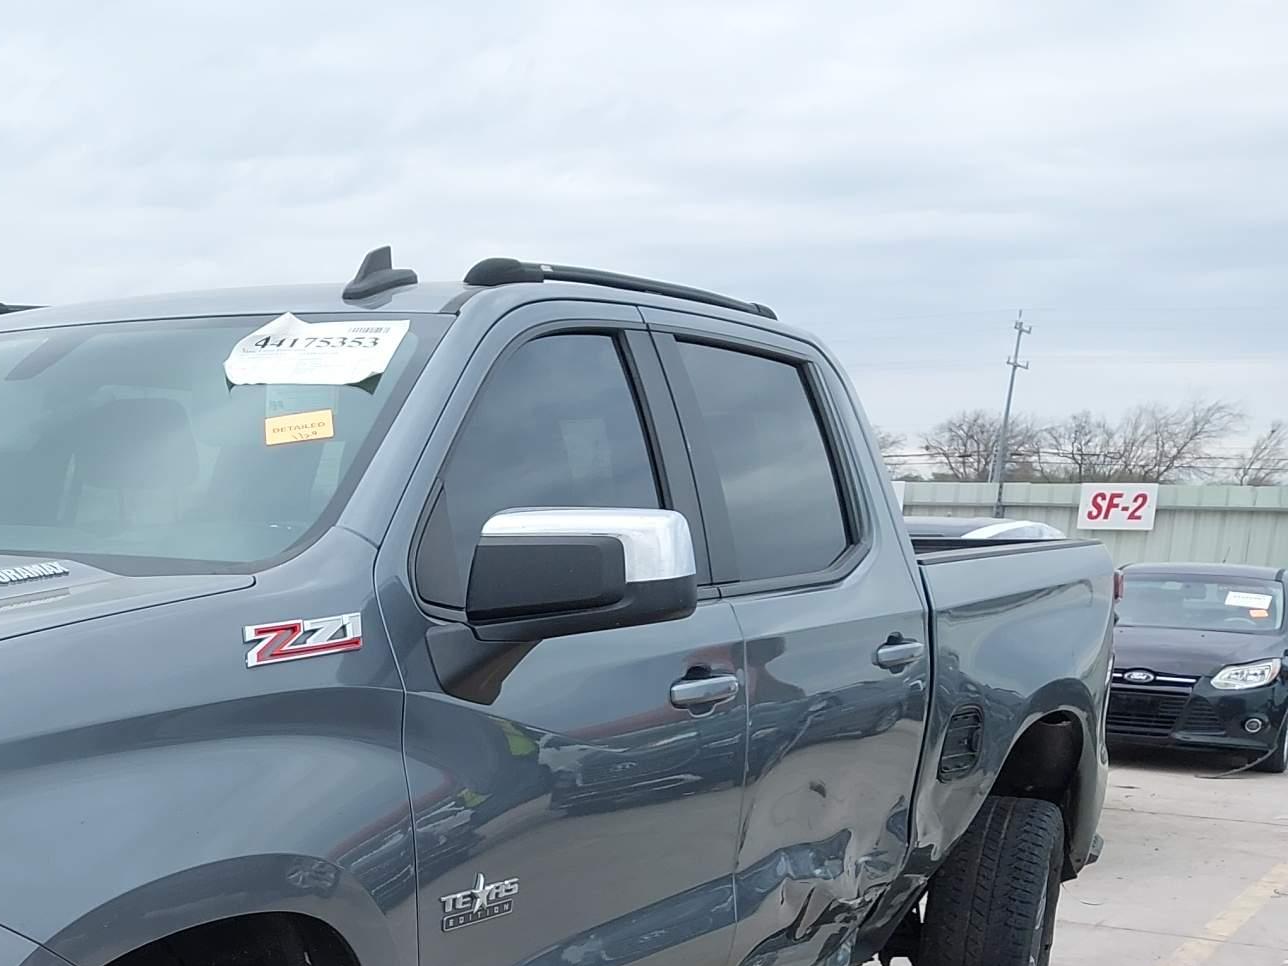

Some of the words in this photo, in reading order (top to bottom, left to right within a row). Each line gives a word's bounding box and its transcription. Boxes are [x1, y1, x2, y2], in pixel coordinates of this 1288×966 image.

[254, 335, 380, 349] 44175353
[272, 421, 326, 433] DETAILED
[1087, 492, 1148, 520] SF-2
[242, 612, 362, 668] Z71
[440, 873, 519, 914] TEXAS
[448, 902, 510, 927] EDITION
